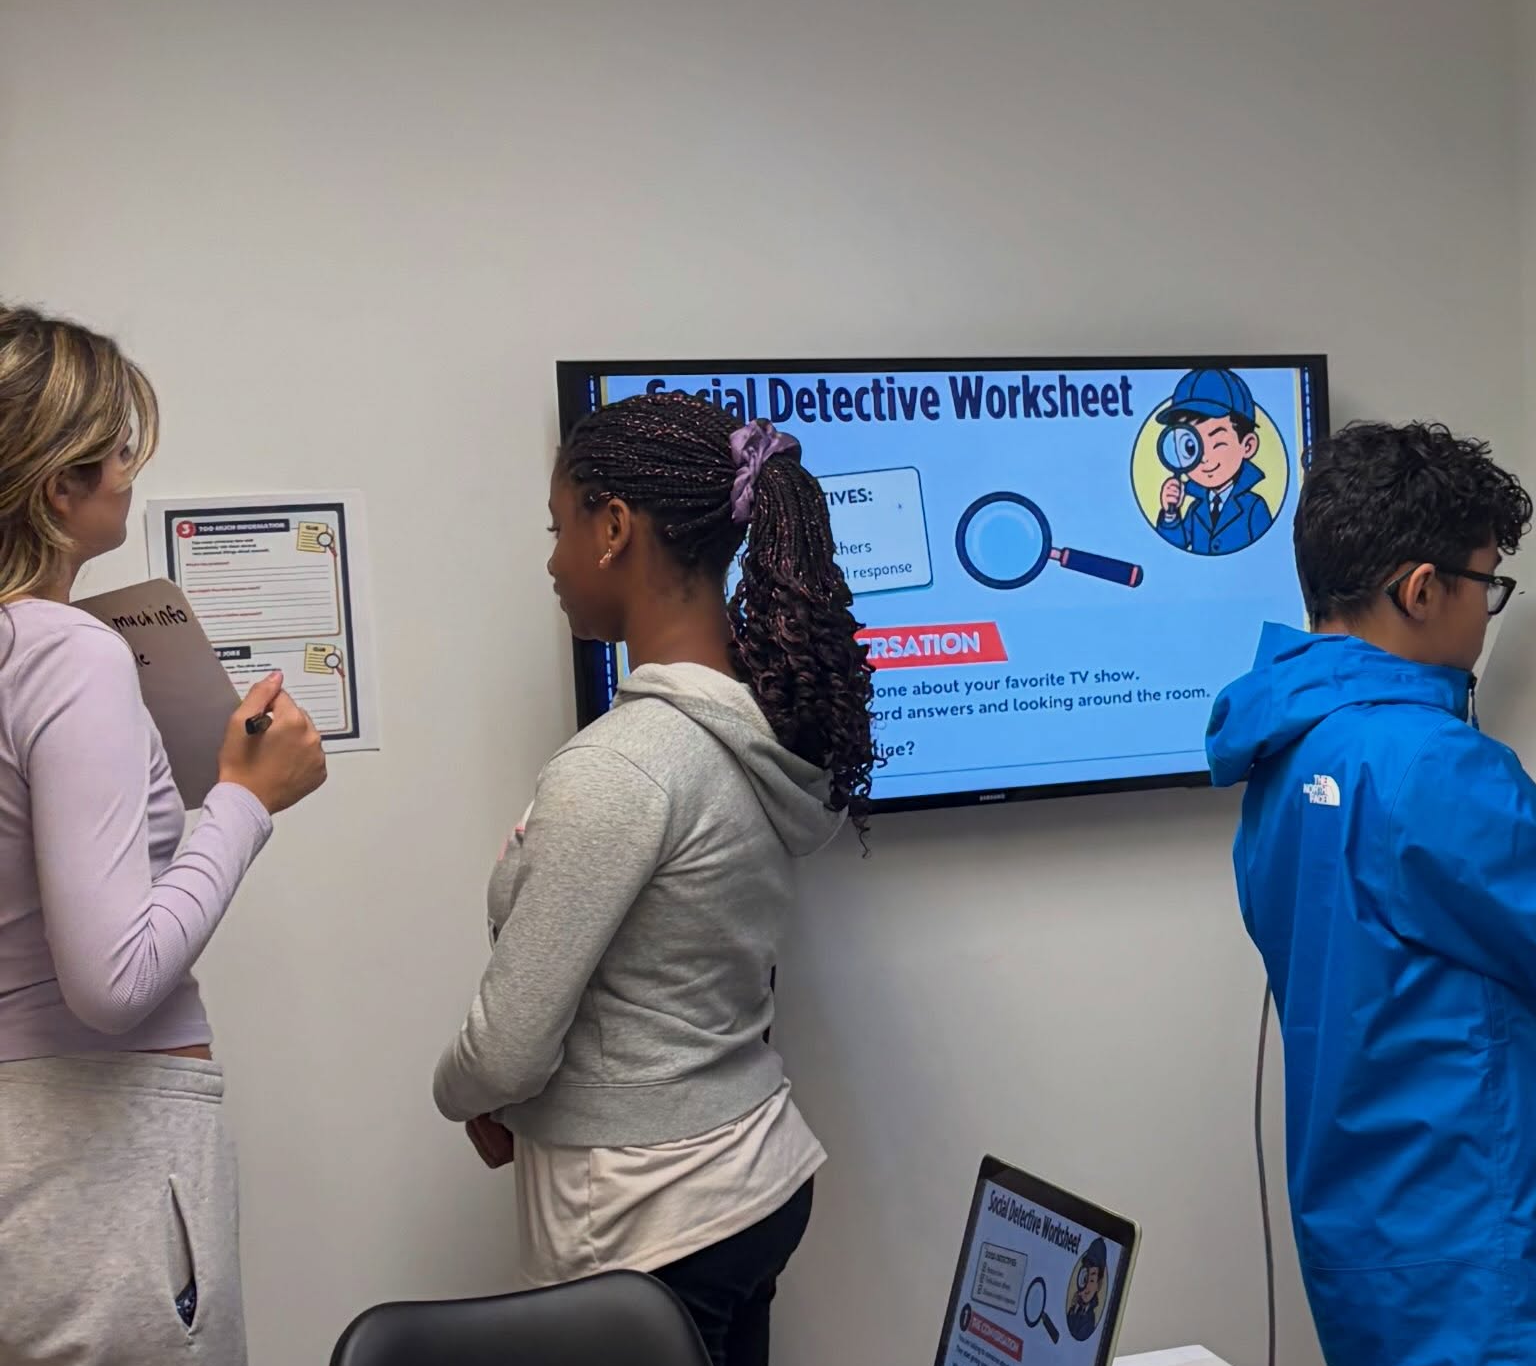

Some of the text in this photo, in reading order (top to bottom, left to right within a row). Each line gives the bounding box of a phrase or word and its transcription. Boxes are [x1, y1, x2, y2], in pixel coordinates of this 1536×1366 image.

[768, 376, 940, 423] Detective
[948, 374, 1134, 419] Worksheet
[852, 561, 913, 580] response
[154, 604, 188, 627] info
[912, 680, 959, 695] about
[965, 679, 1001, 696] your
[1006, 673, 1065, 690] favorite
[1069, 671, 1089, 685] TV
[1094, 669, 1140, 684] show.
[908, 702, 974, 720] answers
[979, 699, 1008, 714] and
[1013, 697, 1073, 712] looking
[1078, 691, 1132, 707] around
[1137, 689, 1161, 703] the
[1166, 688, 1211, 700] room.
[988, 1190, 1082, 1255] Social Detective Worksheet
